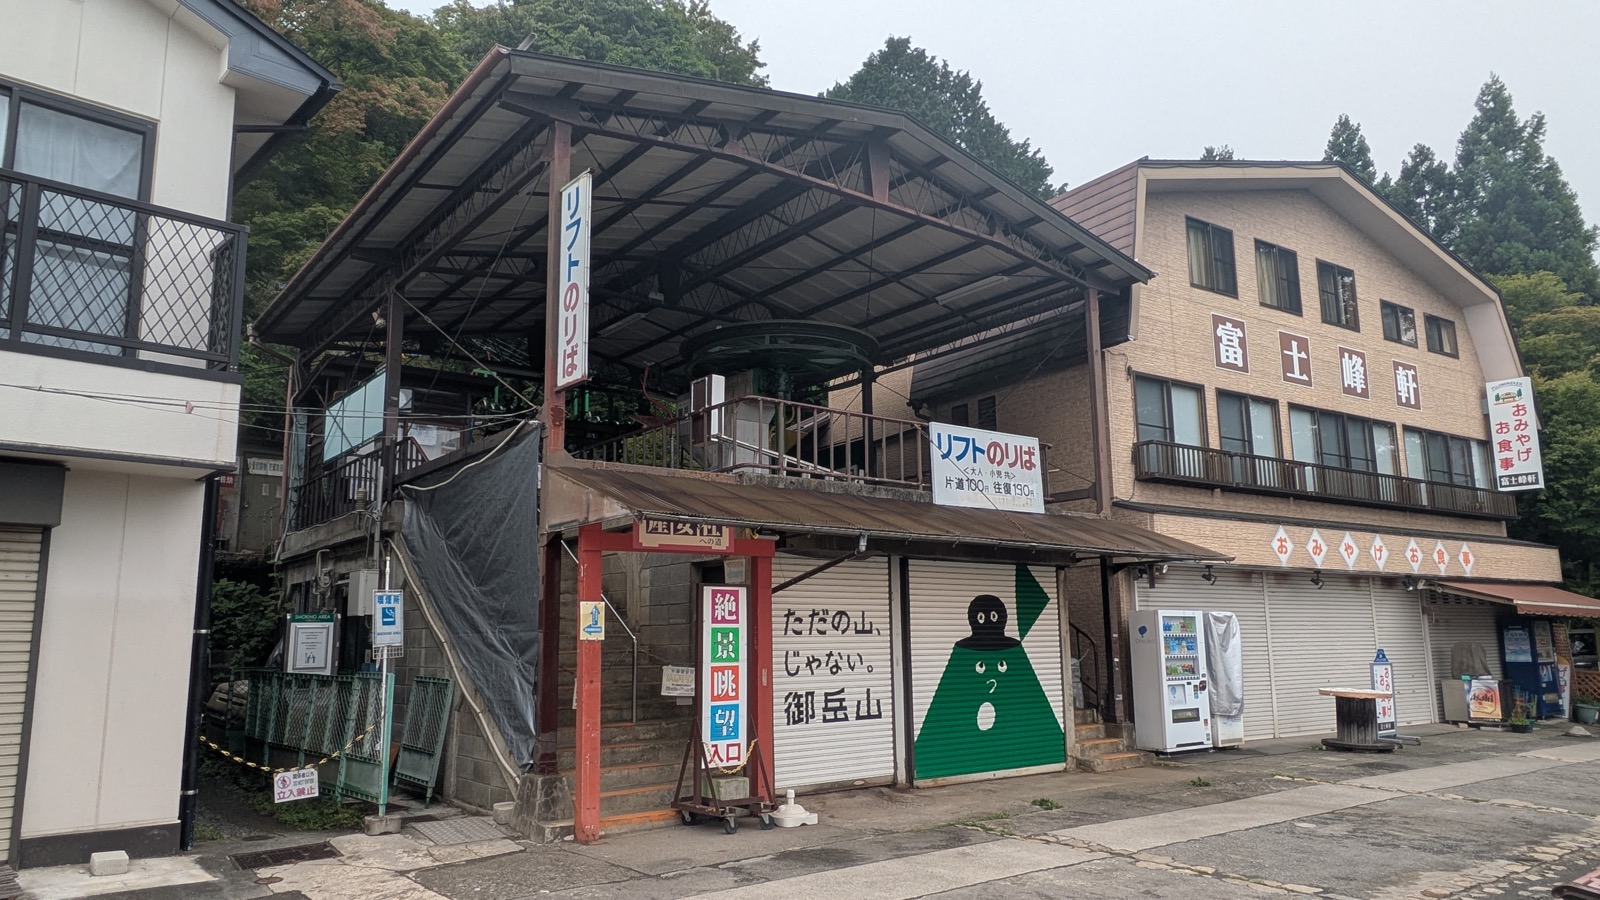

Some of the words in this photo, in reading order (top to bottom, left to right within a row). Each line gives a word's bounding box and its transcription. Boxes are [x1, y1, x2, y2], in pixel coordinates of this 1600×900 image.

[563, 186, 582, 379] リフトのりば
[1216, 321, 1418, 405] 富士峰軒
[1495, 421, 1515, 471] お食事
[1512, 403, 1532, 462] おみやげ
[936, 432, 1037, 471] リフトのりば
[1500, 474, 1537, 486] 富士峰軒
[699, 538, 722, 546] への道
[1276, 536, 1384, 562] おみやげ
[1409, 547, 1472, 567] お食事
[783, 607, 882, 637] ただの山、
[713, 592, 738, 737] 絶景眺望
[783, 650, 875, 677] じゃない。
[783, 687, 883, 726] 御岳山
[1470, 692, 1494, 703] Asahi
[709, 742, 742, 765] 入口
[277, 786, 316, 800] 立入禁止
